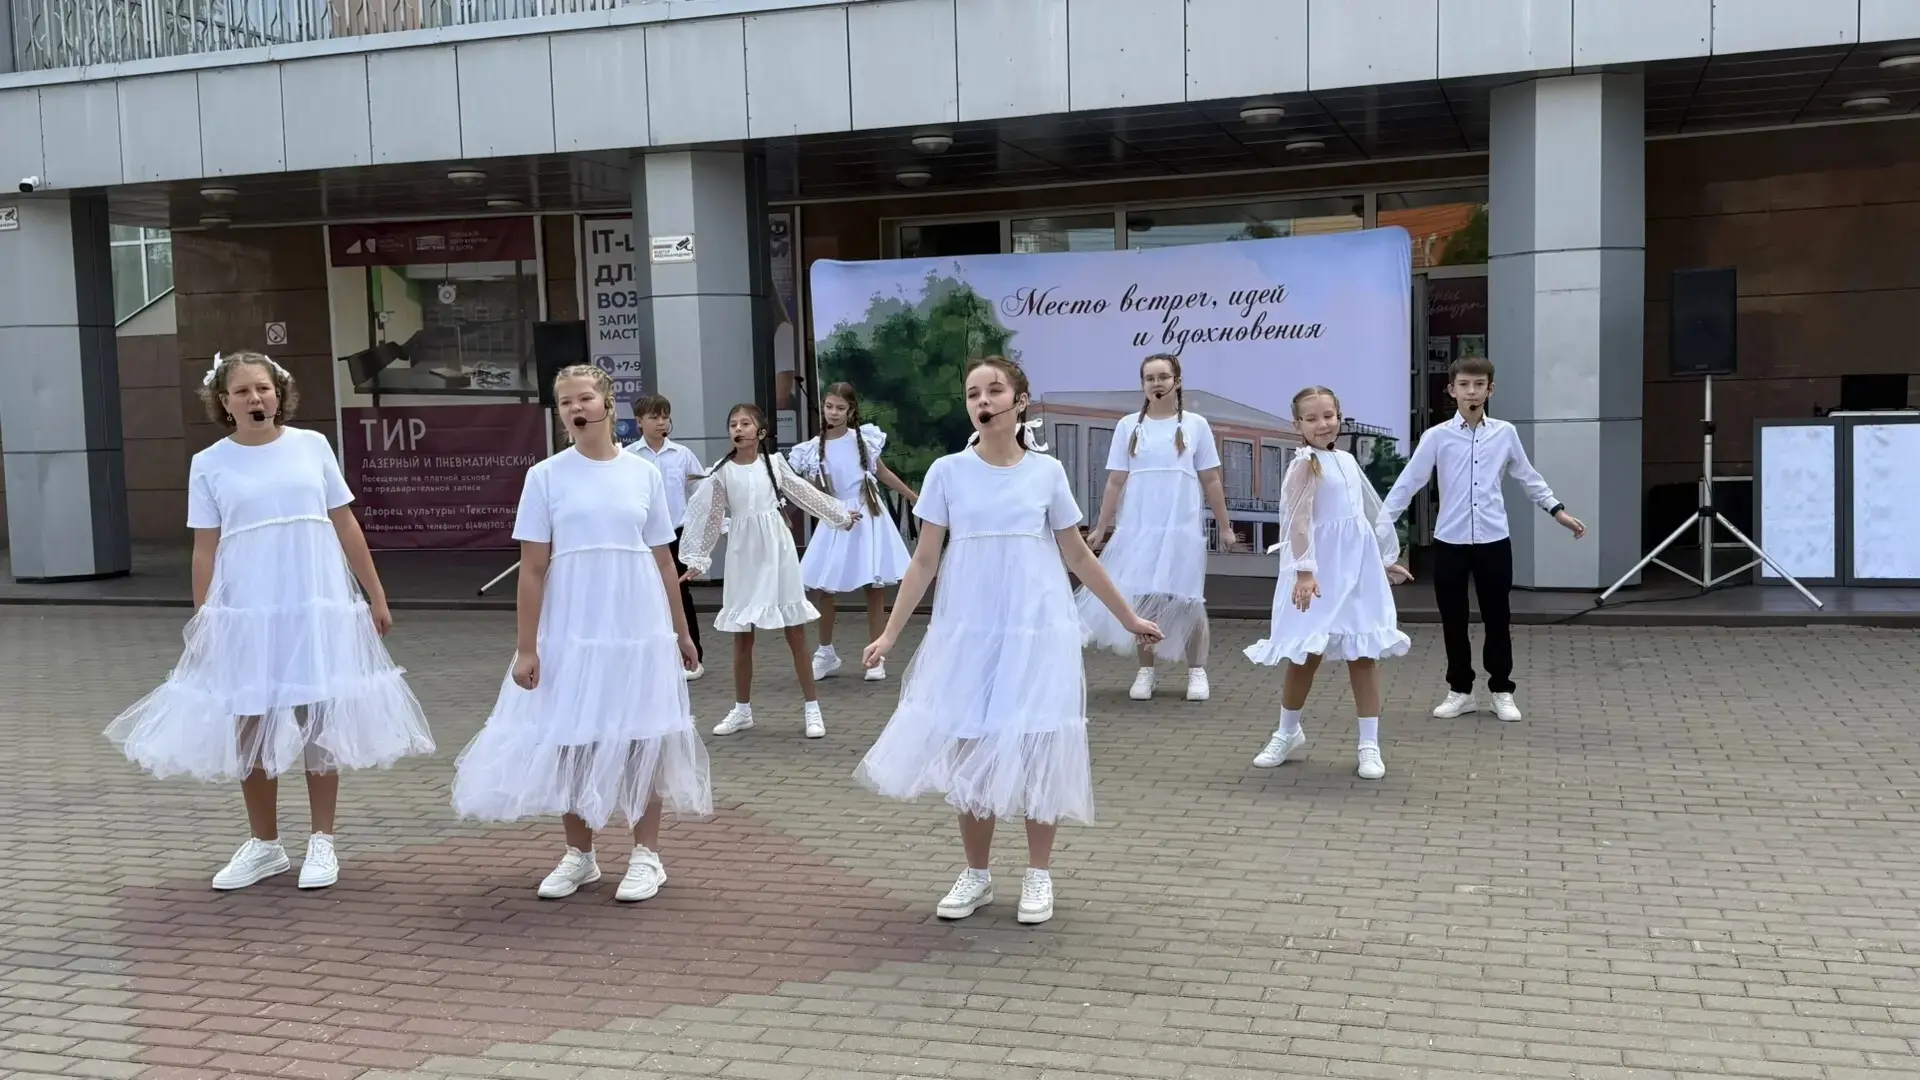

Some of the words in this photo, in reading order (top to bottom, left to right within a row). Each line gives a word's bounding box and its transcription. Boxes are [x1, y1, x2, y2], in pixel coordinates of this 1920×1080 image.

[595, 263, 637, 287] ДЛ
[1000, 285, 1111, 318] Место
[1119, 283, 1218, 324] встреч,
[1228, 283, 1290, 318] идей
[598, 314, 637, 326] ЗАПИ
[1132, 330, 1155, 347] и
[1161, 311, 1327, 356] вдохновения
[359, 418, 427, 451] ТИР
[361, 455, 420, 469] ЛАЗЕРНЫЙ
[424, 457, 431, 468] И
[435, 453, 536, 468] ПНЕВМАТИЧЕСКИЙ
[362, 474, 409, 484] Посещение
[424, 473, 459, 482] платной
[461, 474, 491, 482] основе
[375, 484, 450, 495] предварительной
[364, 505, 403, 518] Дворец
[407, 507, 456, 519] культуры
[365, 523, 412, 533] Информация
[426, 523, 463, 532] телефону:
